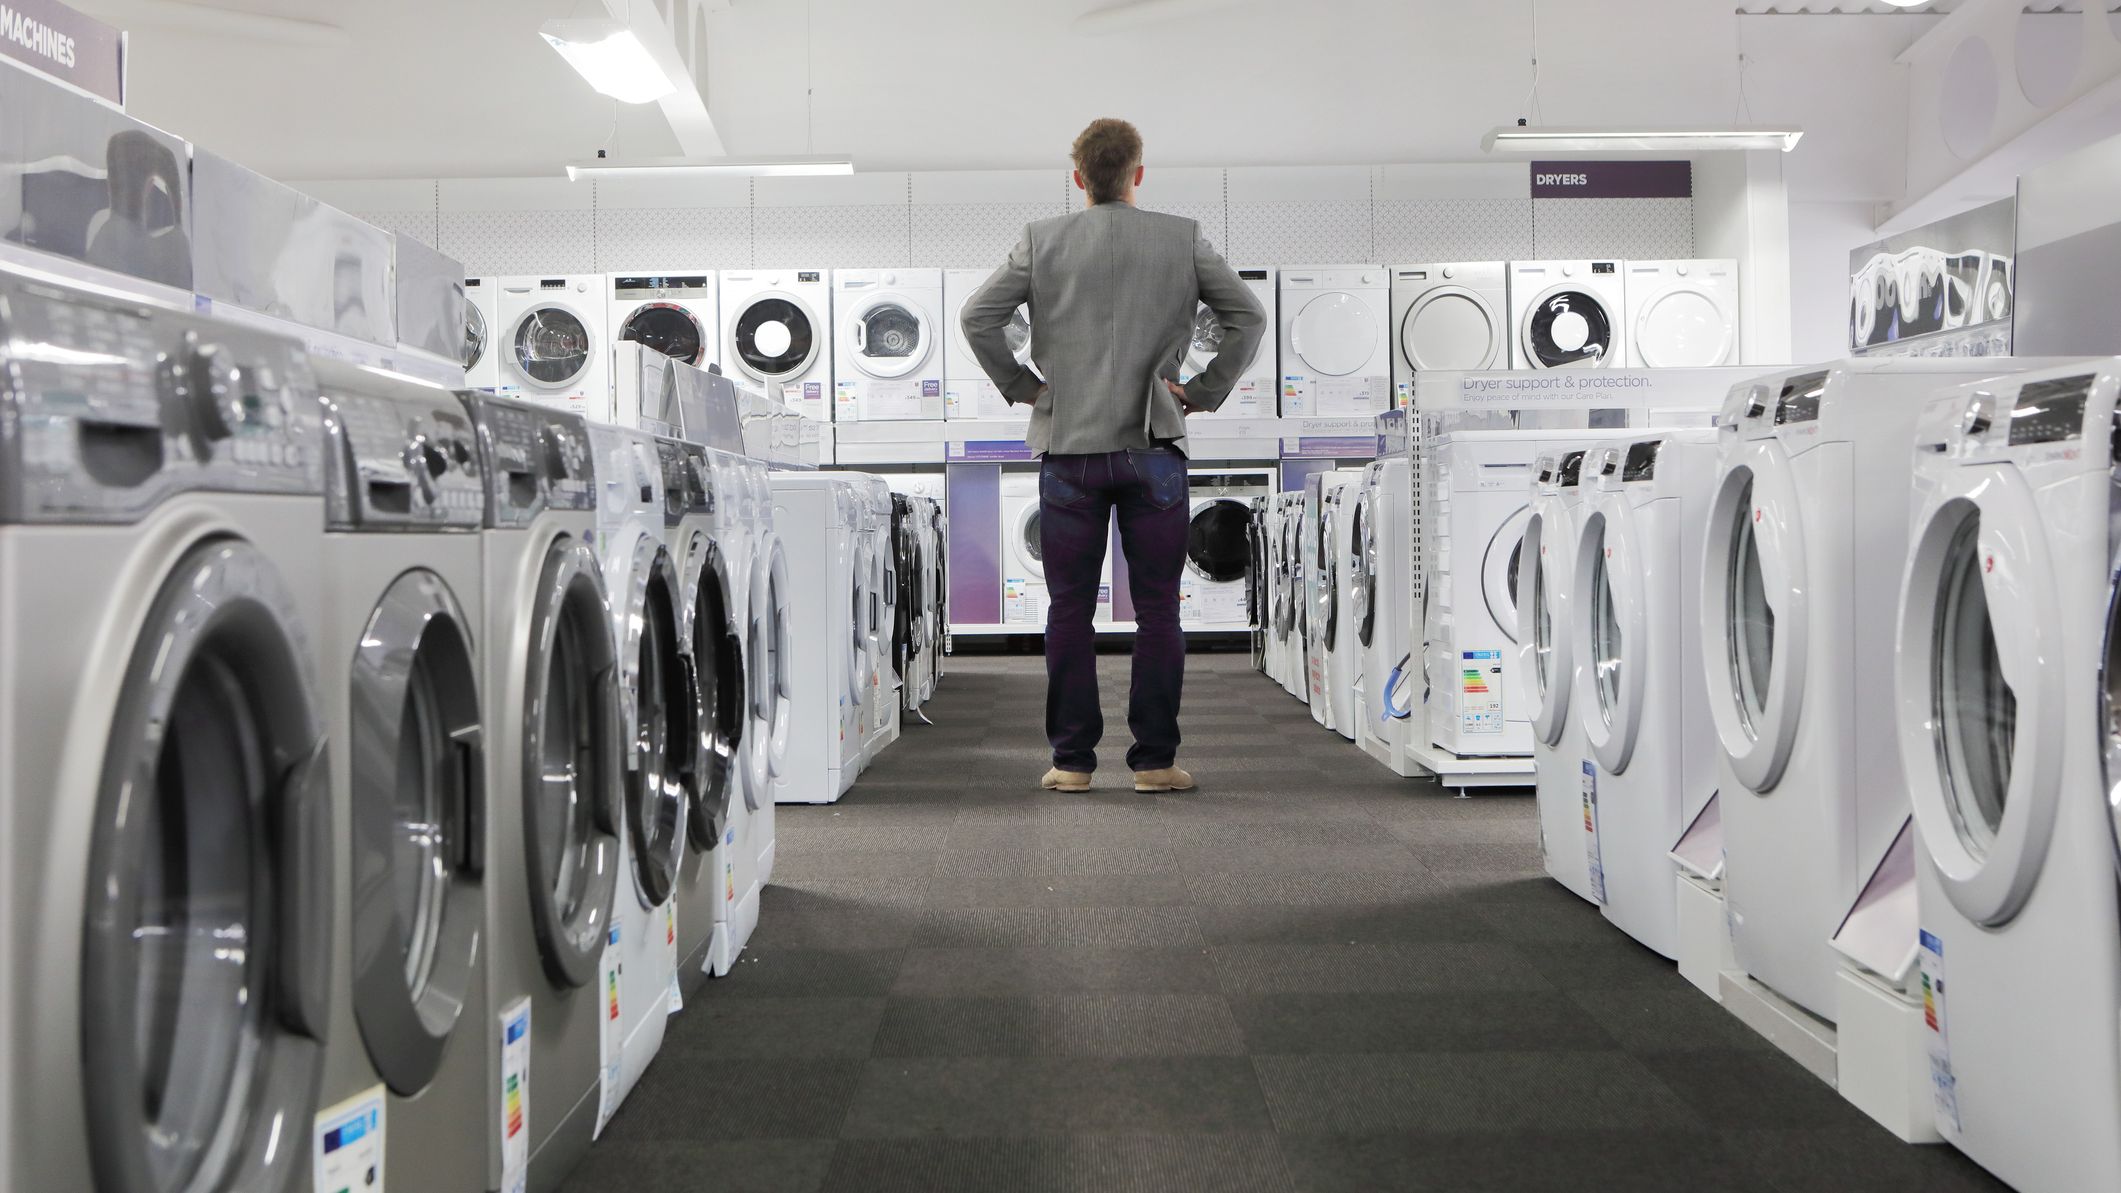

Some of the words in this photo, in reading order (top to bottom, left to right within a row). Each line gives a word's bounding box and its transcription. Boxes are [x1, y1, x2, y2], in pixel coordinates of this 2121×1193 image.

[0, 4, 75, 68] MACHINES
[1536, 173, 1588, 186] DRYERS
[1463, 377, 1502, 391] Dryer
[1506, 376, 1561, 390] support
[1564, 375, 1575, 389] &
[1579, 374, 1652, 390] protection.
[1463, 393, 1484, 403] Enjoy
[1487, 394, 1510, 402] peace
[1512, 393, 1520, 401] of
[1522, 393, 1540, 401] mind
[1576, 392, 1593, 400] Care
